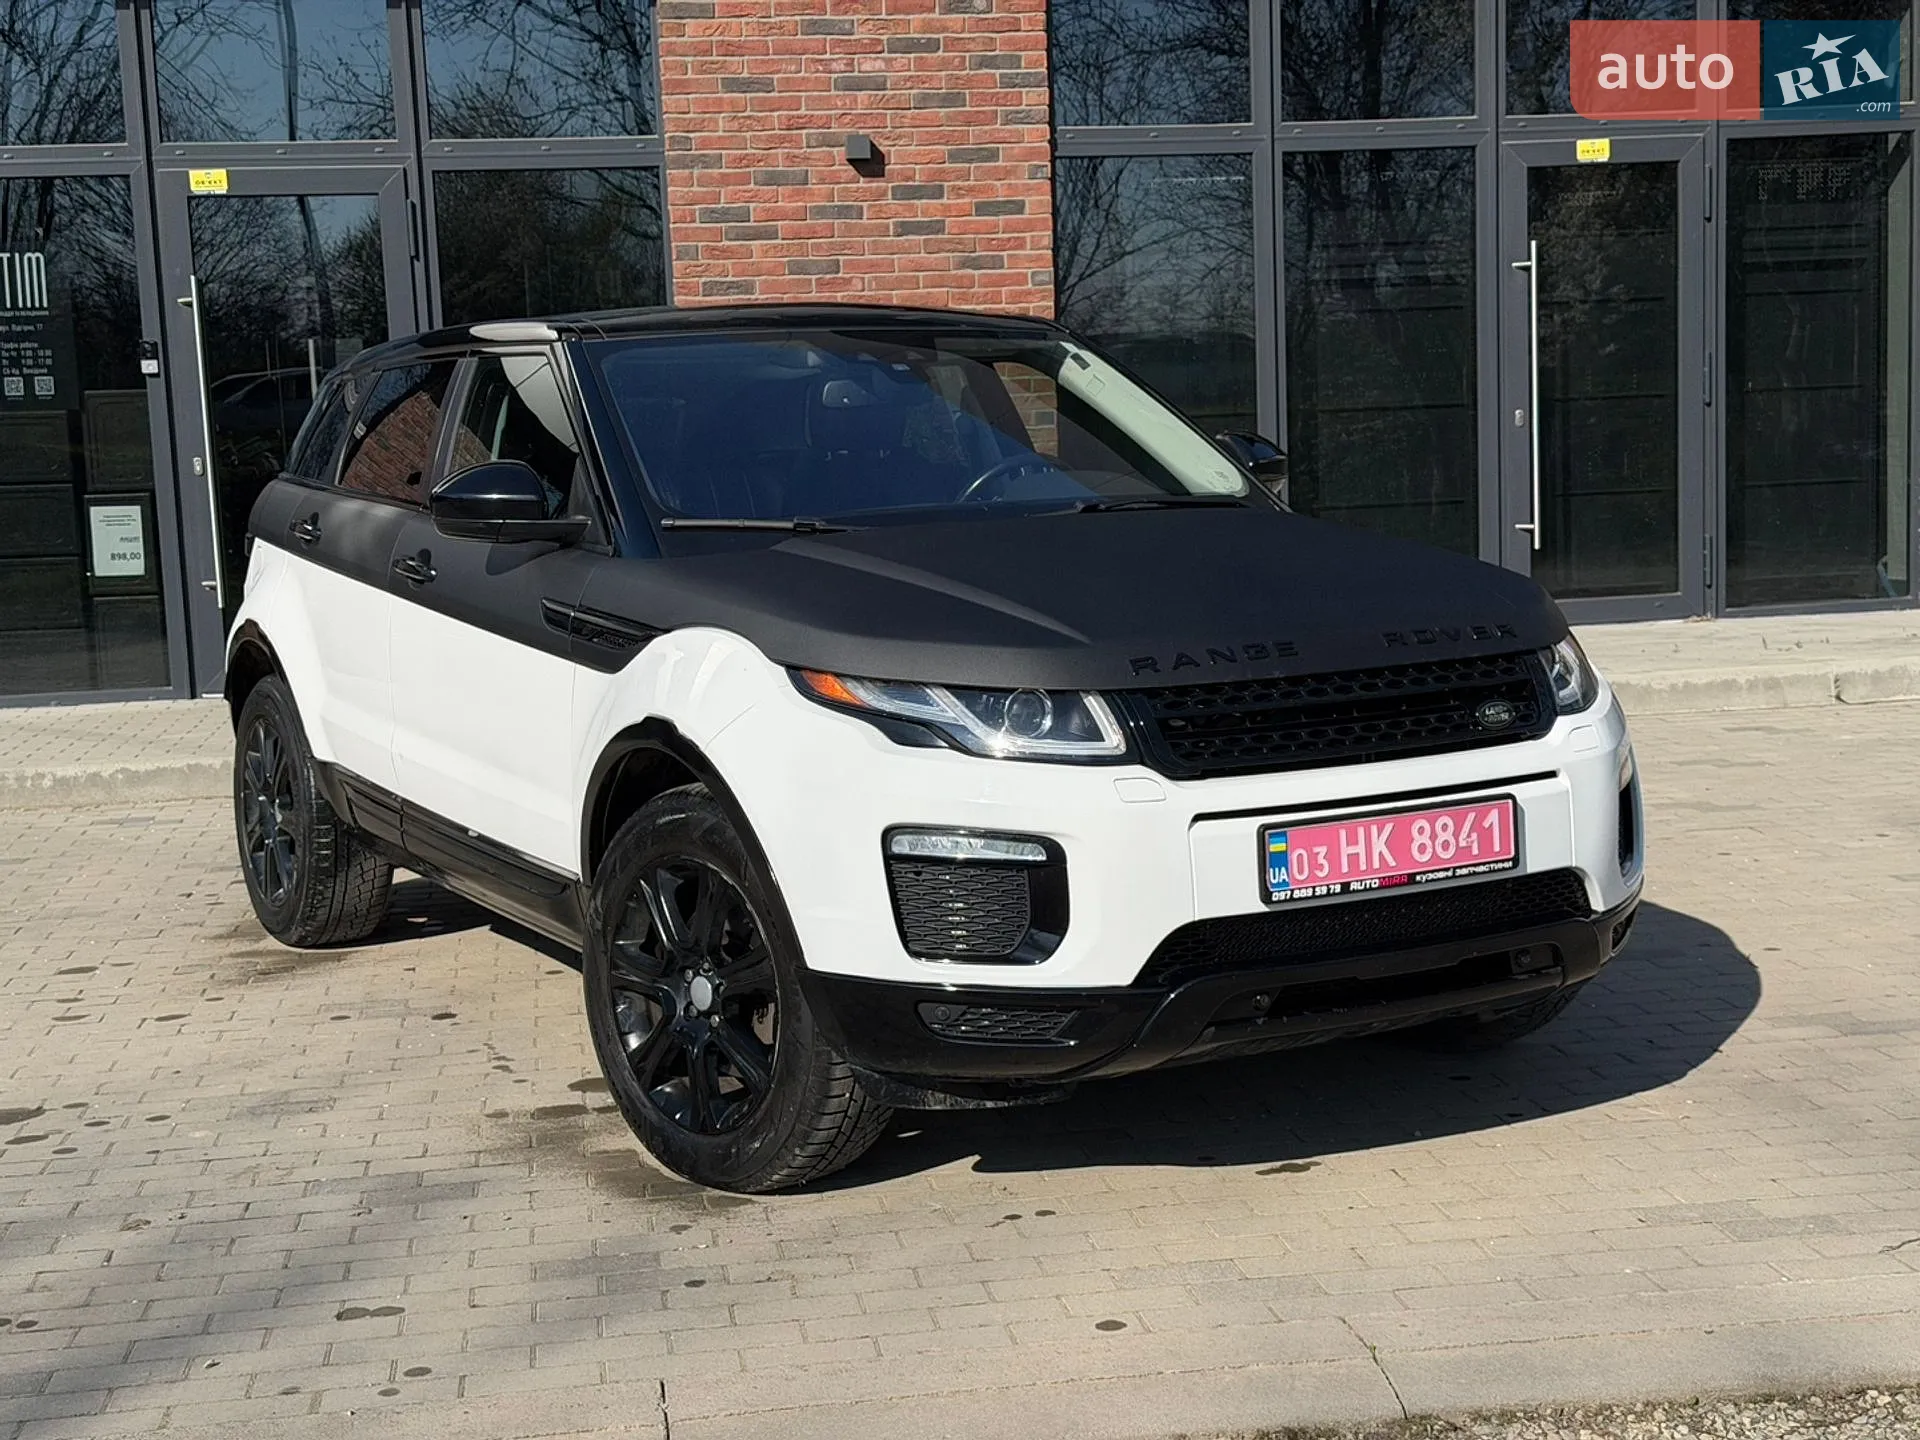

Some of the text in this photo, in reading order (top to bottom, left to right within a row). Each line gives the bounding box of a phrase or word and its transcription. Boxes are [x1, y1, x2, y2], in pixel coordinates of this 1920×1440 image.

[1129, 624, 1517, 676] RANGE ROVER
[1291, 846, 1330, 880] 03
[1410, 807, 1501, 863] 8841
[1269, 866, 1289, 884] UA
[1455, 861, 1513, 876] запчастини
